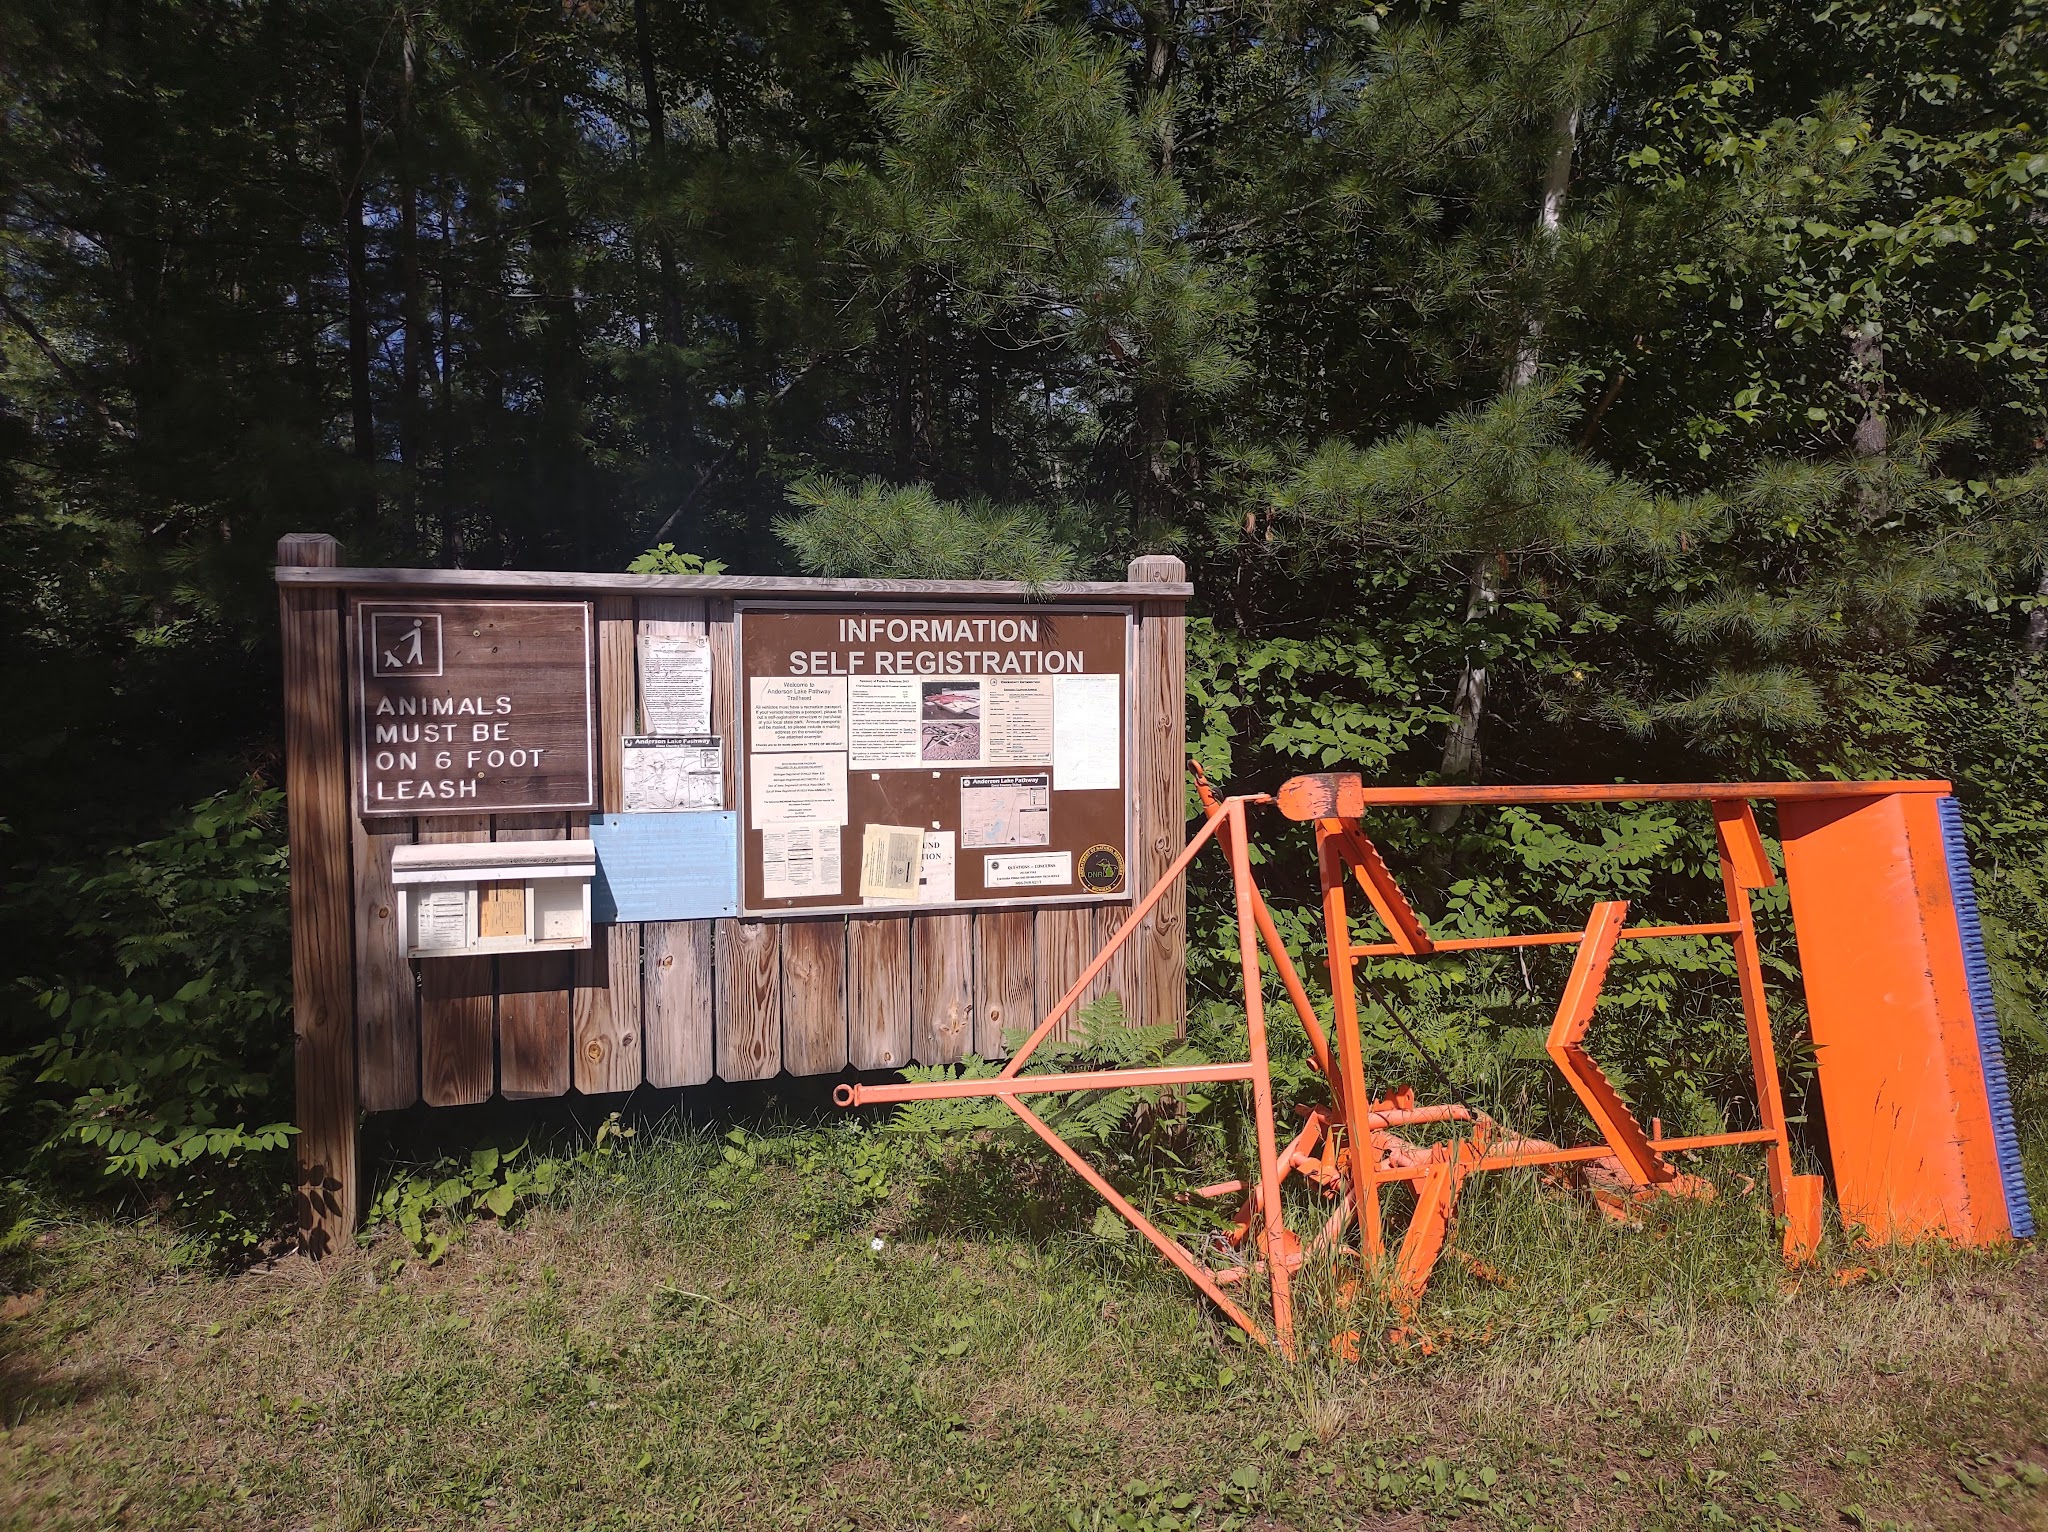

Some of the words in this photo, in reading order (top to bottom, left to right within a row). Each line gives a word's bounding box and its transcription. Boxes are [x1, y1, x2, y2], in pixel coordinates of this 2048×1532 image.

[839, 619, 1038, 642] INFORMATION
[789, 651, 865, 675] SELF
[875, 651, 1084, 674] REGISTRATION
[376, 695, 512, 715] ANIMALS
[376, 723, 457, 743] MUST
[473, 722, 509, 742] BE
[376, 751, 417, 770] ON
[436, 751, 451, 769] 6
[467, 749, 544, 768] FOOT
[377, 779, 476, 800] LEASH
